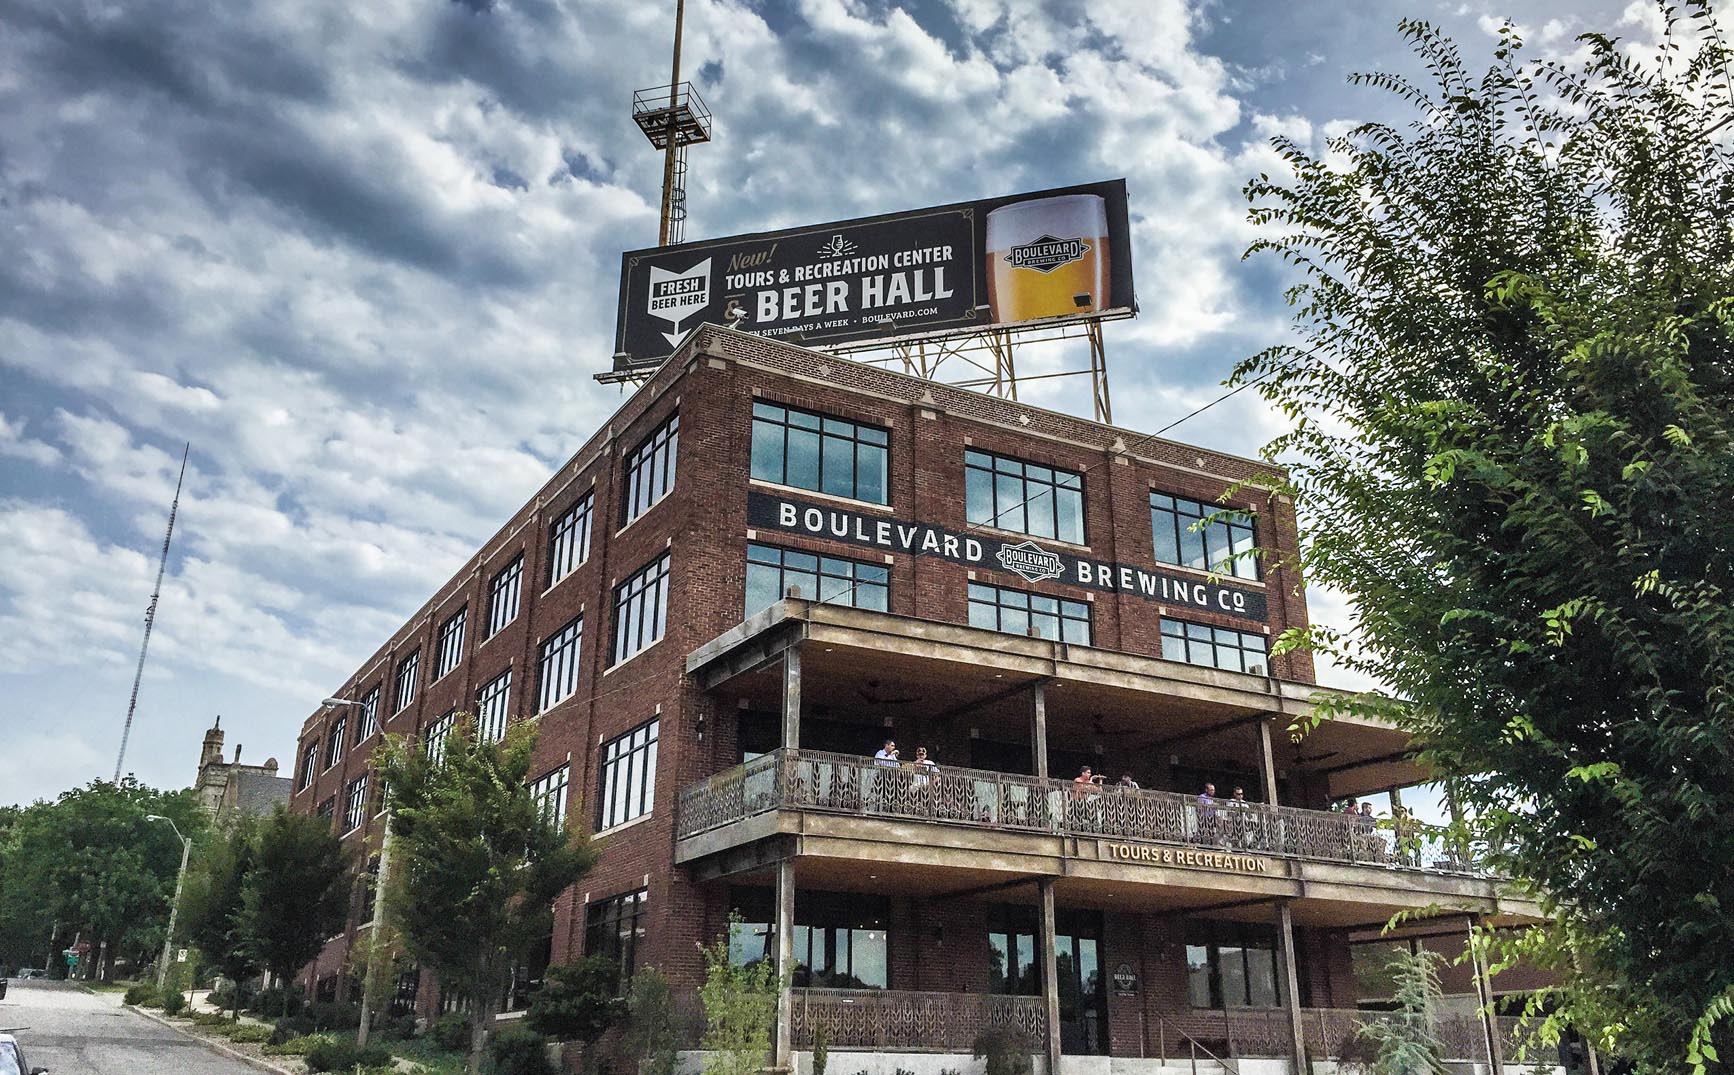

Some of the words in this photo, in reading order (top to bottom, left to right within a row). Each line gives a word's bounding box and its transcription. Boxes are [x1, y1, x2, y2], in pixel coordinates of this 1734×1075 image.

[727, 244, 778, 273] New!
[1015, 241, 1078, 264] BOULEVARD
[1028, 257, 1056, 265] BREWING
[726, 271, 774, 290] TOURS
[779, 269, 790, 284] &
[795, 254, 889, 281] RECREATION
[894, 246, 953, 267] CENTER
[660, 278, 699, 296] FRESH
[756, 281, 849, 323] BEER
[861, 267, 954, 309] HALL
[652, 297, 677, 310] BEER
[680, 293, 706, 306] HERE
[762, 327, 790, 337] SEVEN
[816, 322, 822, 330] A
[824, 319, 849, 328] WEEK
[862, 307, 938, 324] BOULEVARD.COM
[778, 502, 985, 563] BOULEVARD
[1077, 560, 1208, 607] BREWING
[1005, 549, 1055, 573] BOULEVARD
[1016, 564, 1038, 572] BREWING
[1109, 844, 1159, 861] TOURS
[1163, 849, 1172, 862] &
[1176, 850, 1267, 872] RECREATION
